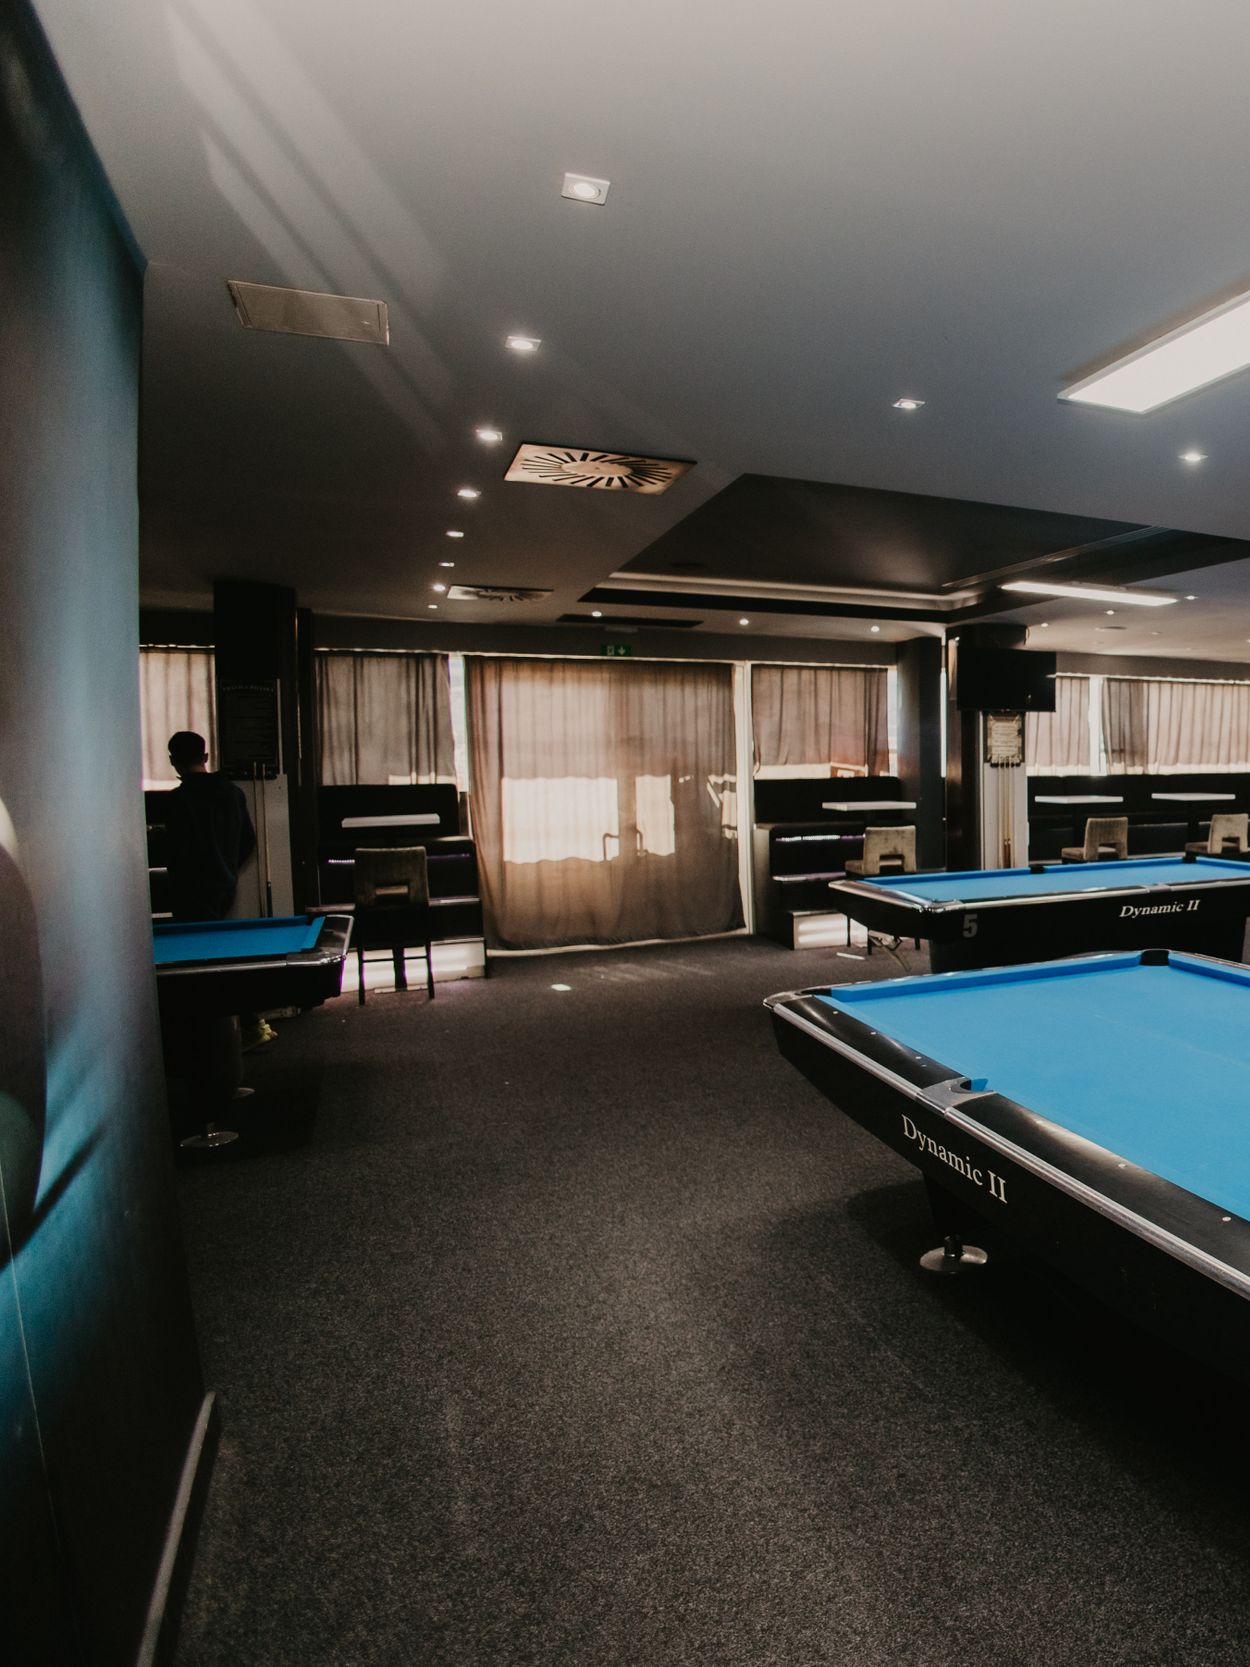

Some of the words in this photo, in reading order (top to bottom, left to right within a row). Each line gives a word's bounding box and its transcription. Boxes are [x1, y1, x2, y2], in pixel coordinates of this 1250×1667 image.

[1120, 902, 1184, 918] Dynamic
[1187, 900, 1200, 911] II
[963, 914, 978, 938] 5
[902, 1114, 983, 1185] Dynamic
[987, 1170, 1008, 1204] II
